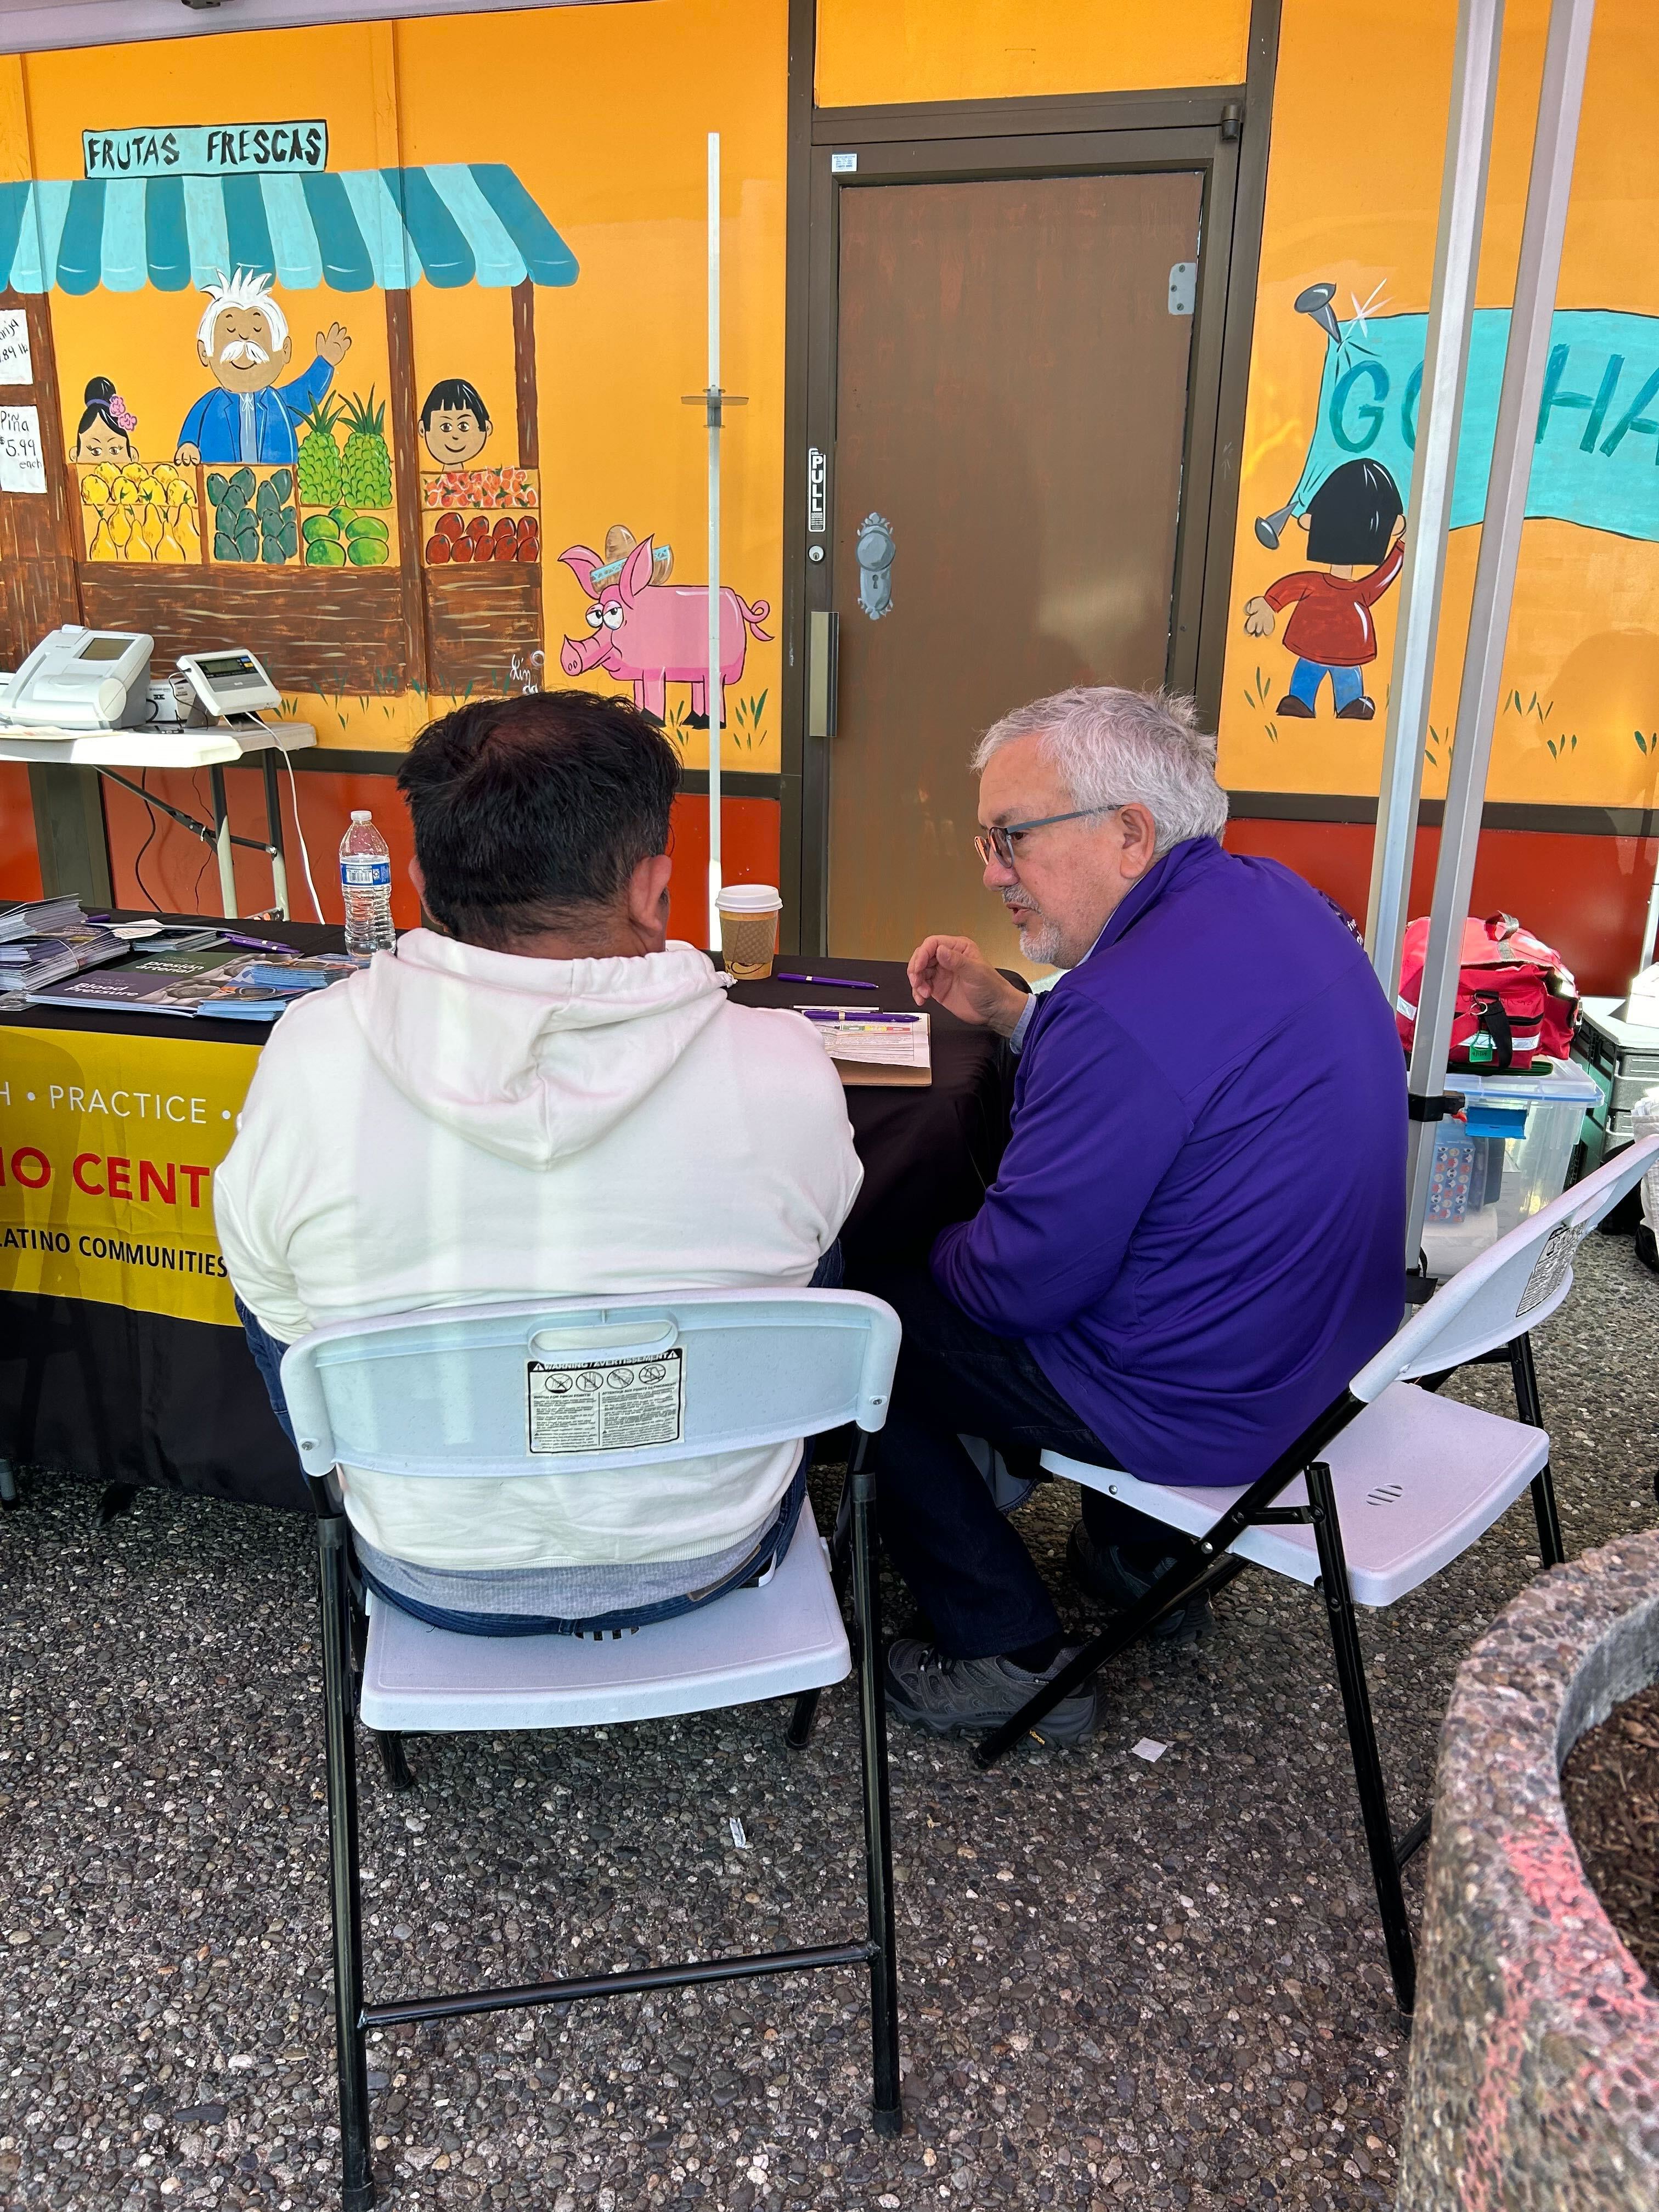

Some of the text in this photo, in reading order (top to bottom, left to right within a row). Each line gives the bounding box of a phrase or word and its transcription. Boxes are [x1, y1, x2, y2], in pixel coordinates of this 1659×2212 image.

[88, 128, 322, 171] FRUTAS FRESCAS
[1, 410, 29, 432] Piña
[811, 455, 823, 512] PULL
[75, 983, 129, 991] Blood
[136, 965, 196, 974] arterial
[49, 1085, 207, 1124] PRACTICE
[0, 1146, 52, 1189] O
[0, 1228, 228, 1278] ATINO COMMUNITIES
